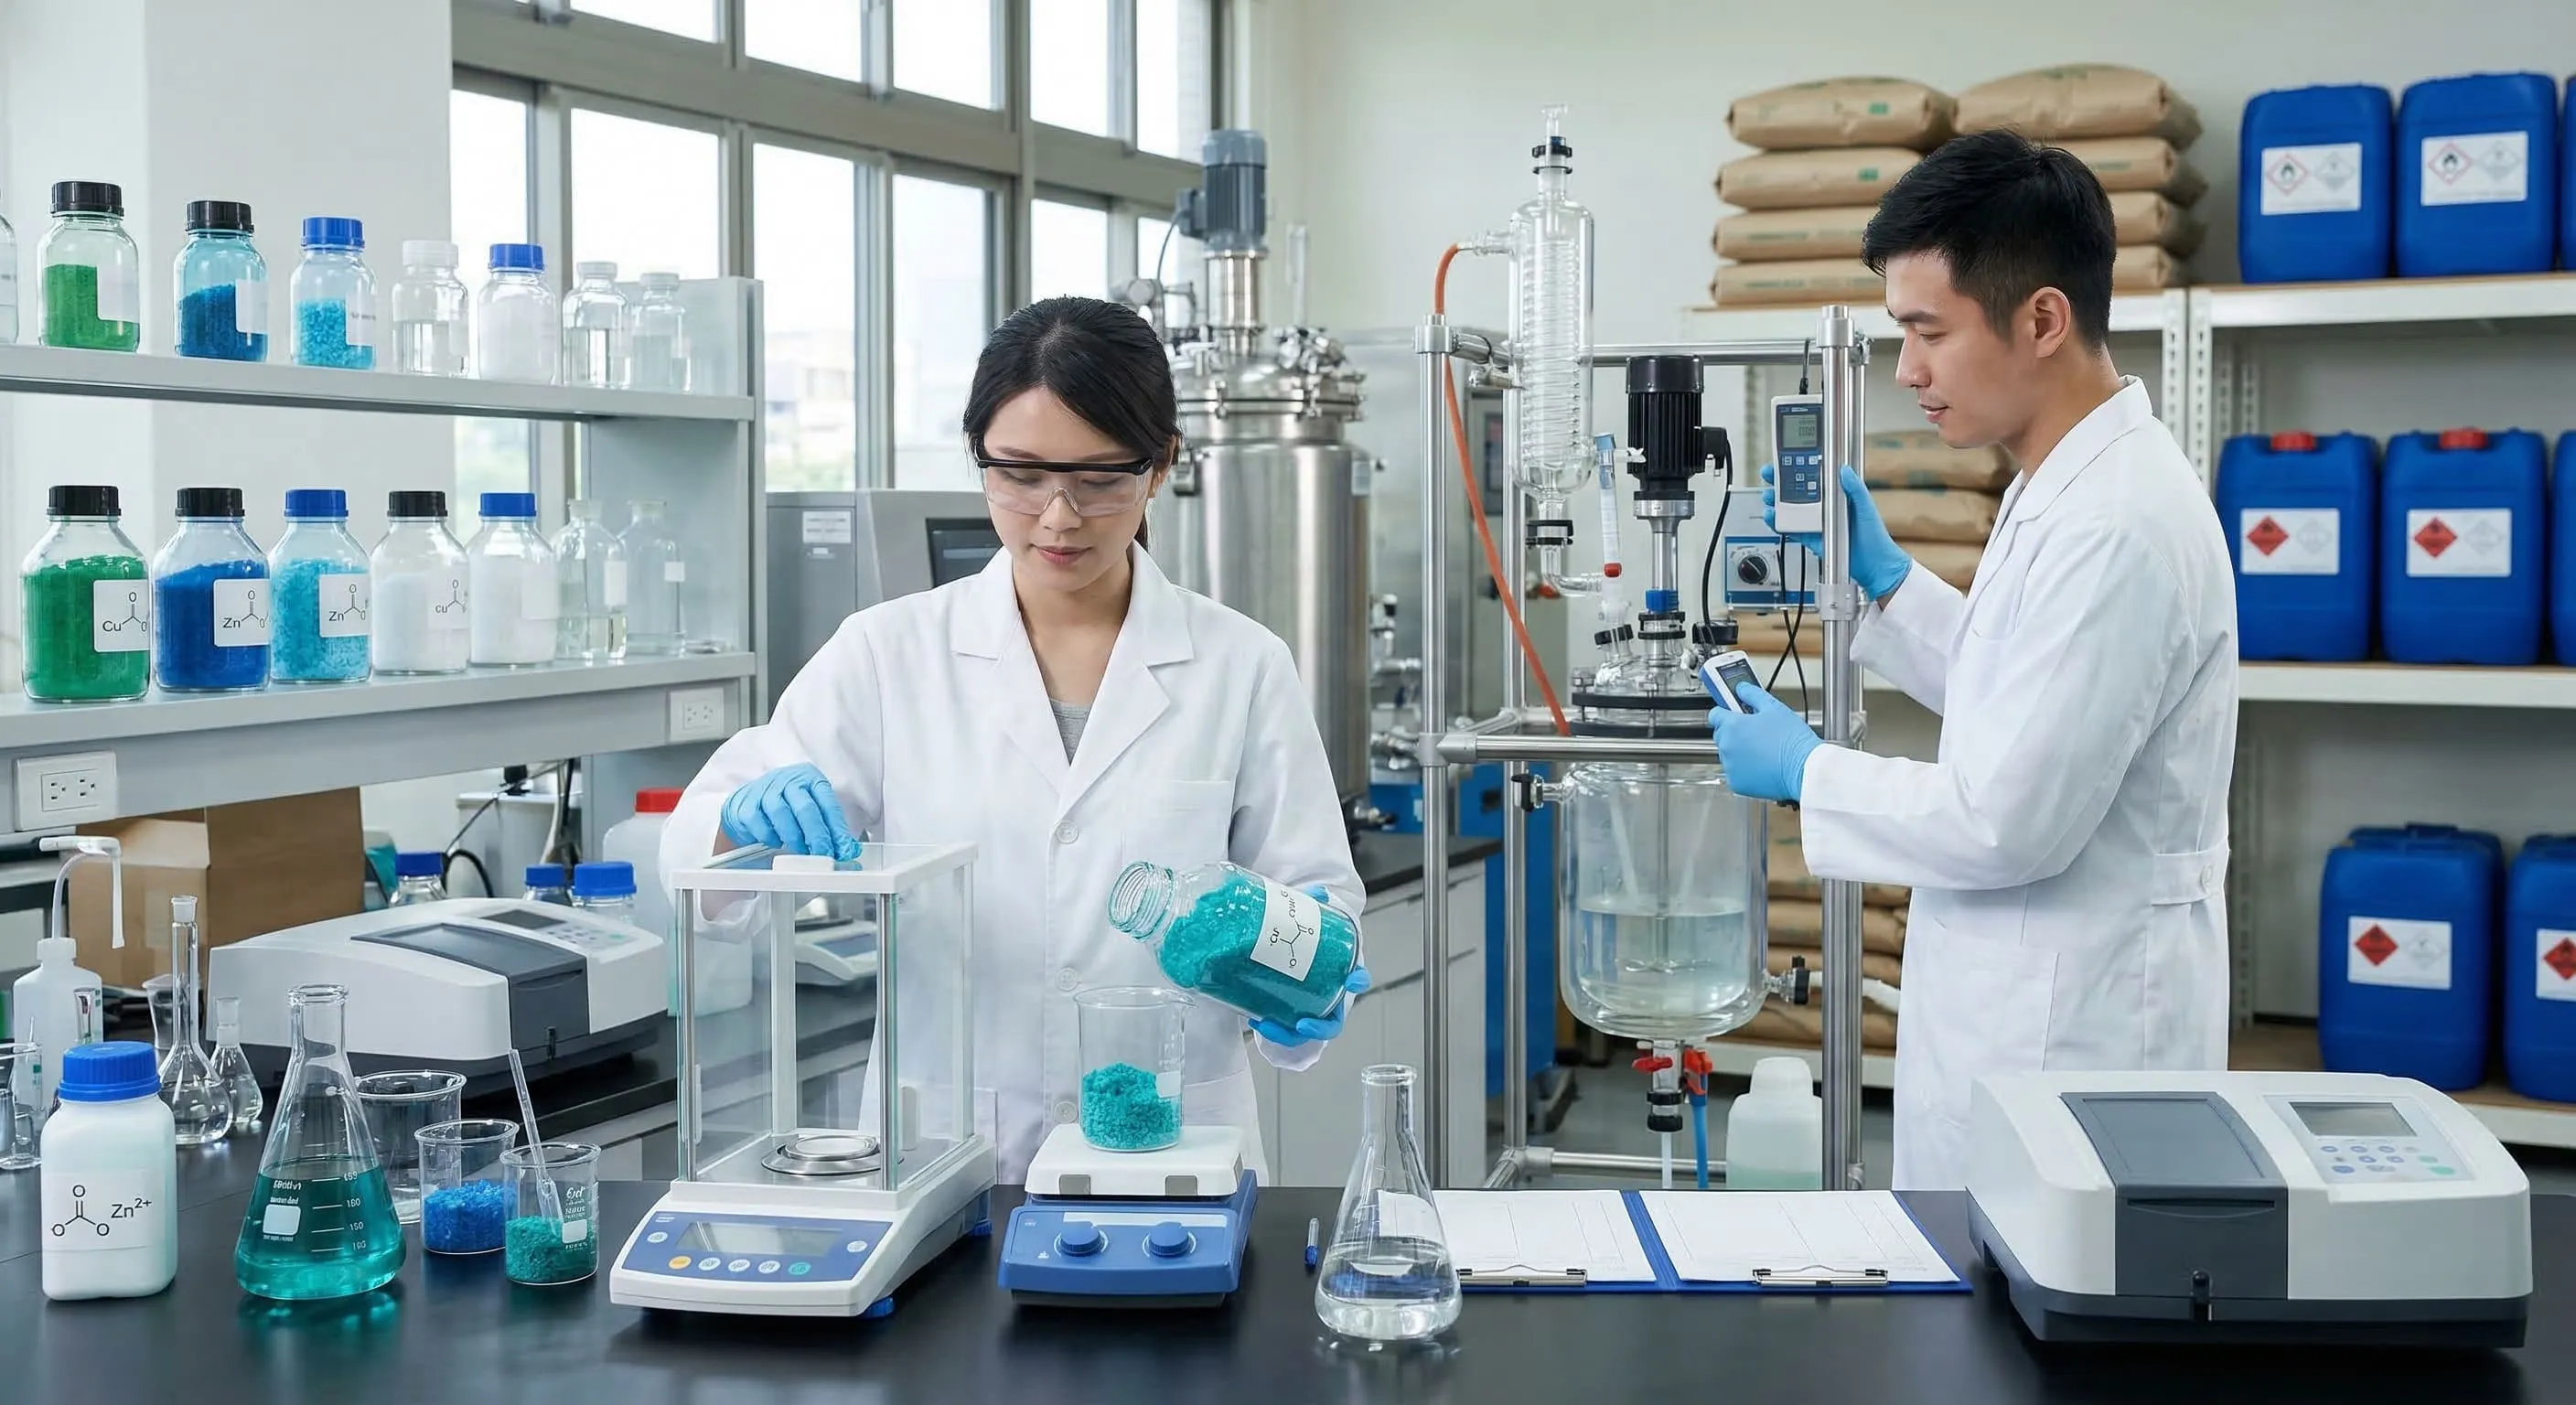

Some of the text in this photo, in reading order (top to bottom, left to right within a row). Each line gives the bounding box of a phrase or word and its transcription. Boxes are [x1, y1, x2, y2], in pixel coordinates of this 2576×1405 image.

[328, 611, 345, 622] Zn
[102, 620, 122, 632] Cu
[222, 617, 241, 628] Zn
